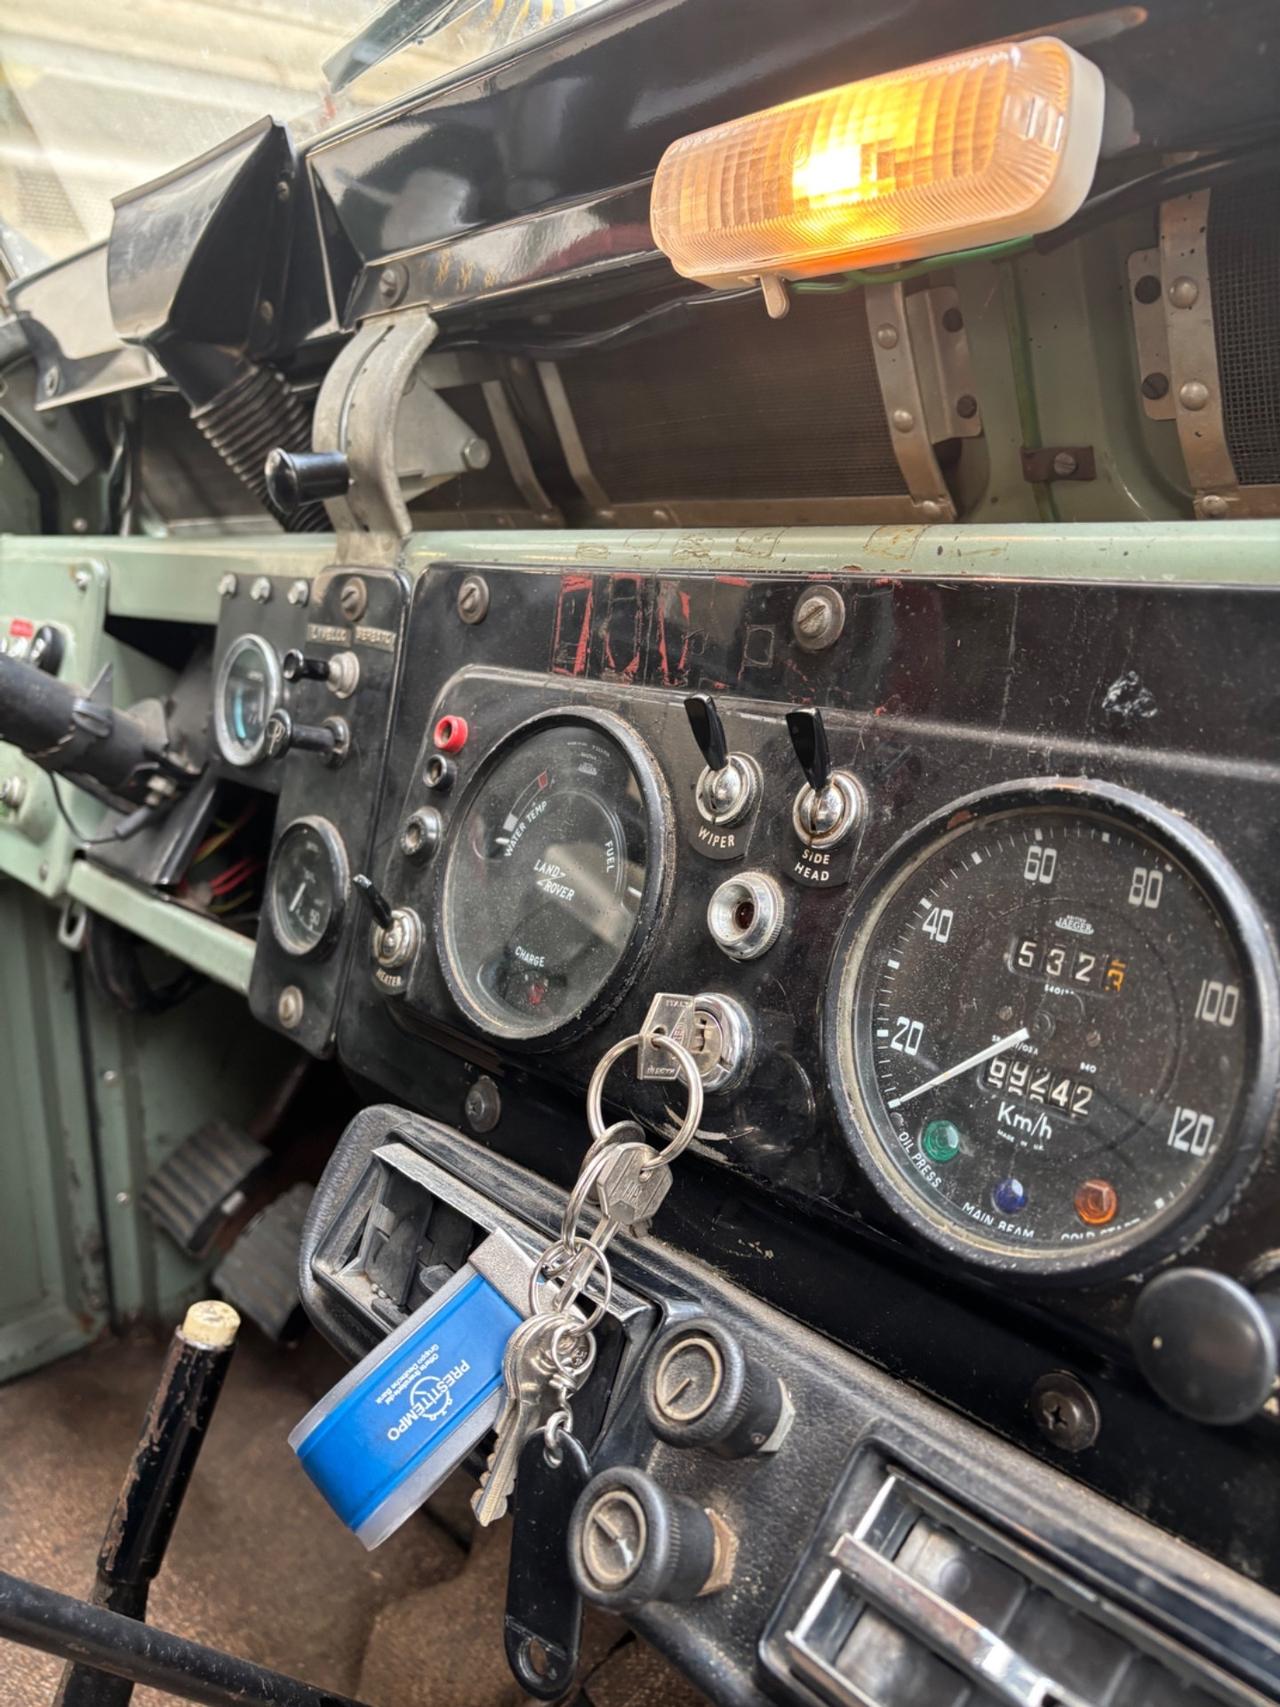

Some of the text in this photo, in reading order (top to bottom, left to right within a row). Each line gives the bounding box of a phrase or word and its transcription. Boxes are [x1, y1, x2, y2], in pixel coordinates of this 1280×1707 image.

[504, 801, 547, 857] WATER TEMP
[698, 826, 736, 849] WIPER
[533, 859, 561, 877] LAND
[604, 840, 616, 873] FUEL
[794, 862, 830, 882] HEAD
[802, 849, 831, 865] SIDE
[1024, 845, 1058, 884] 60
[543, 881, 576, 901] ROVER
[1128, 867, 1164, 909] 80
[922, 906, 954, 944] 40
[1057, 916, 1093, 932] JAEGER
[515, 945, 545, 968] CHARGE
[376, 967, 402, 987] HEATER
[1195, 980, 1240, 1027] 100
[890, 1016, 925, 1056] 20
[997, 1101, 1052, 1139] Km/h
[1167, 1106, 1215, 1156] 120
[899, 1131, 942, 1189] OIL PRESS
[962, 1201, 1035, 1239] MAIN BEAM
[387, 1359, 471, 1440] PRESTITEMPO
